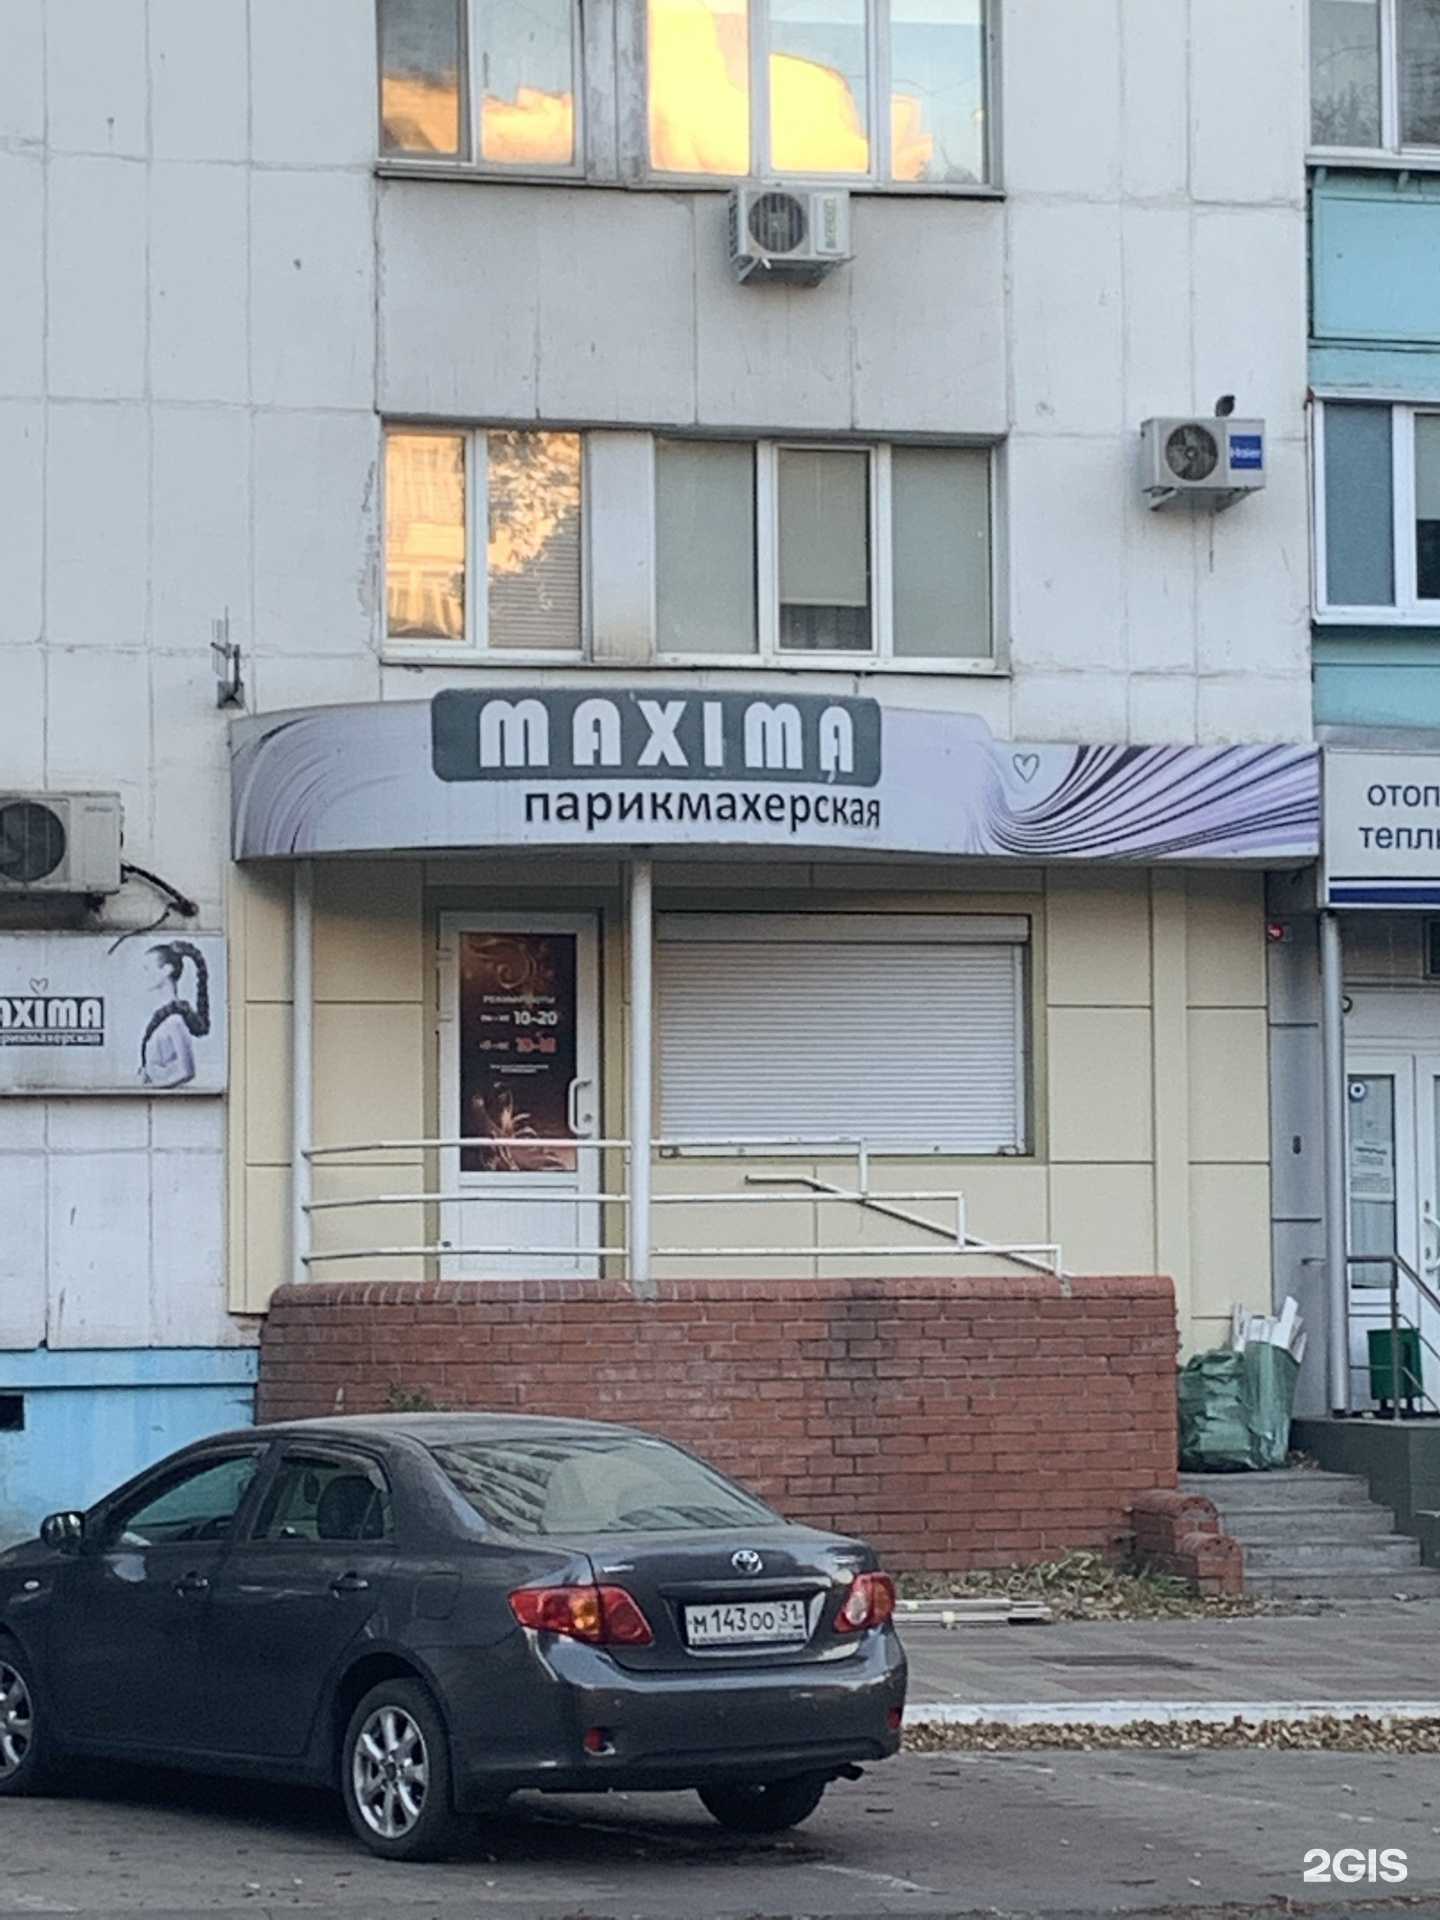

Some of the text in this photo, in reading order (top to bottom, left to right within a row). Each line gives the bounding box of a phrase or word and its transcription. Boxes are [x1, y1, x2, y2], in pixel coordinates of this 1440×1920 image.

[479, 698, 854, 773] MAXIMA
[525, 790, 881, 833] парикмахерская
[1358, 827, 1440, 849] тепл
